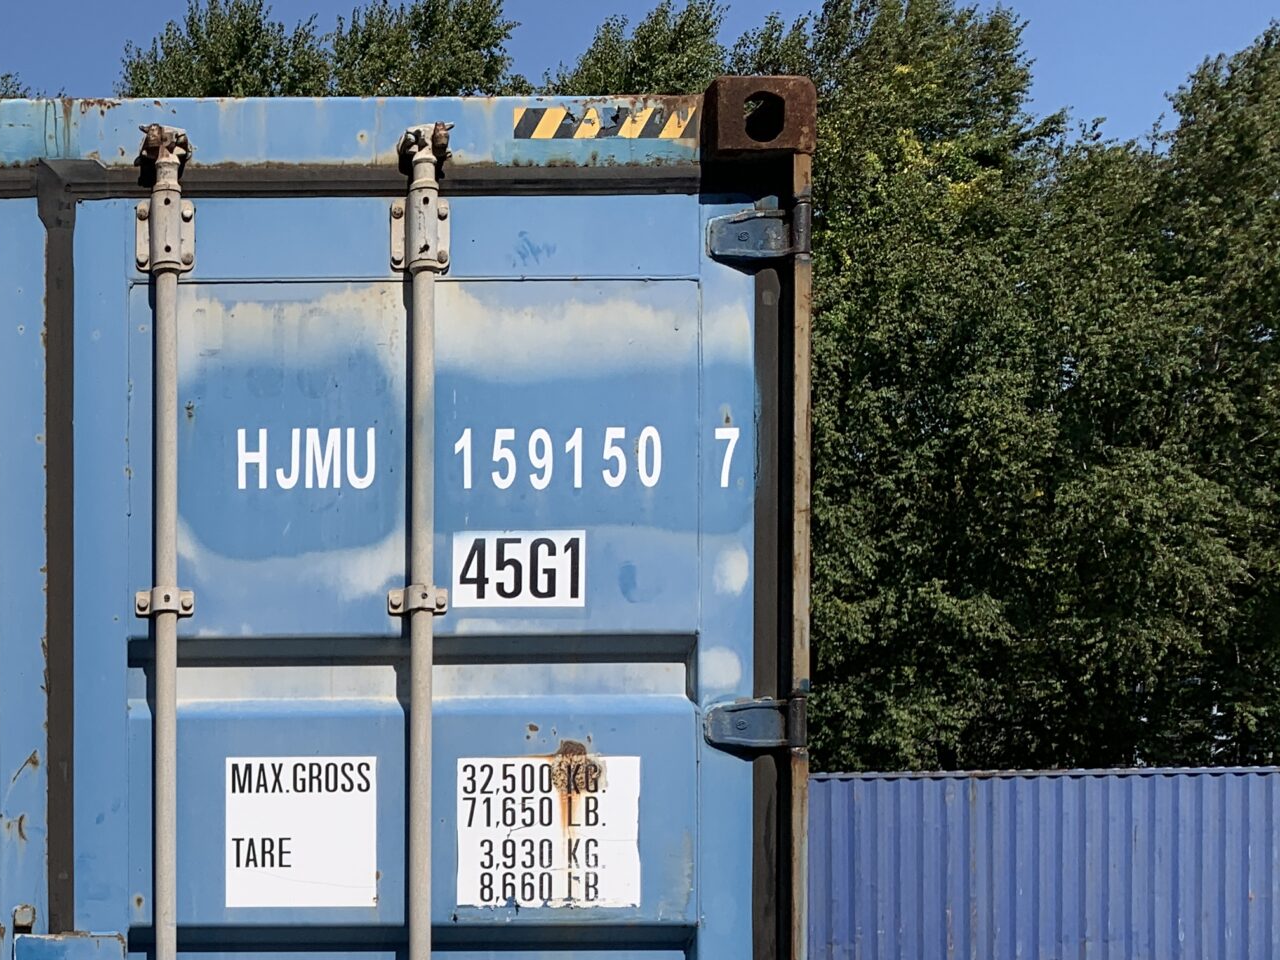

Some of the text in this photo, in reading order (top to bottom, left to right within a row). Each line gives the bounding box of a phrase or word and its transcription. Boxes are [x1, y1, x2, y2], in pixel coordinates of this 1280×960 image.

[237, 426, 740, 489] HJMU 159150 7
[459, 537, 580, 600] 45G1
[232, 763, 371, 793] MAX.GROSS
[462, 764, 553, 795] 32,500
[462, 797, 607, 828] 71,650 LB.
[232, 838, 292, 868] TARE
[480, 839, 553, 869] 3,930
[480, 872, 553, 903] 8,660
